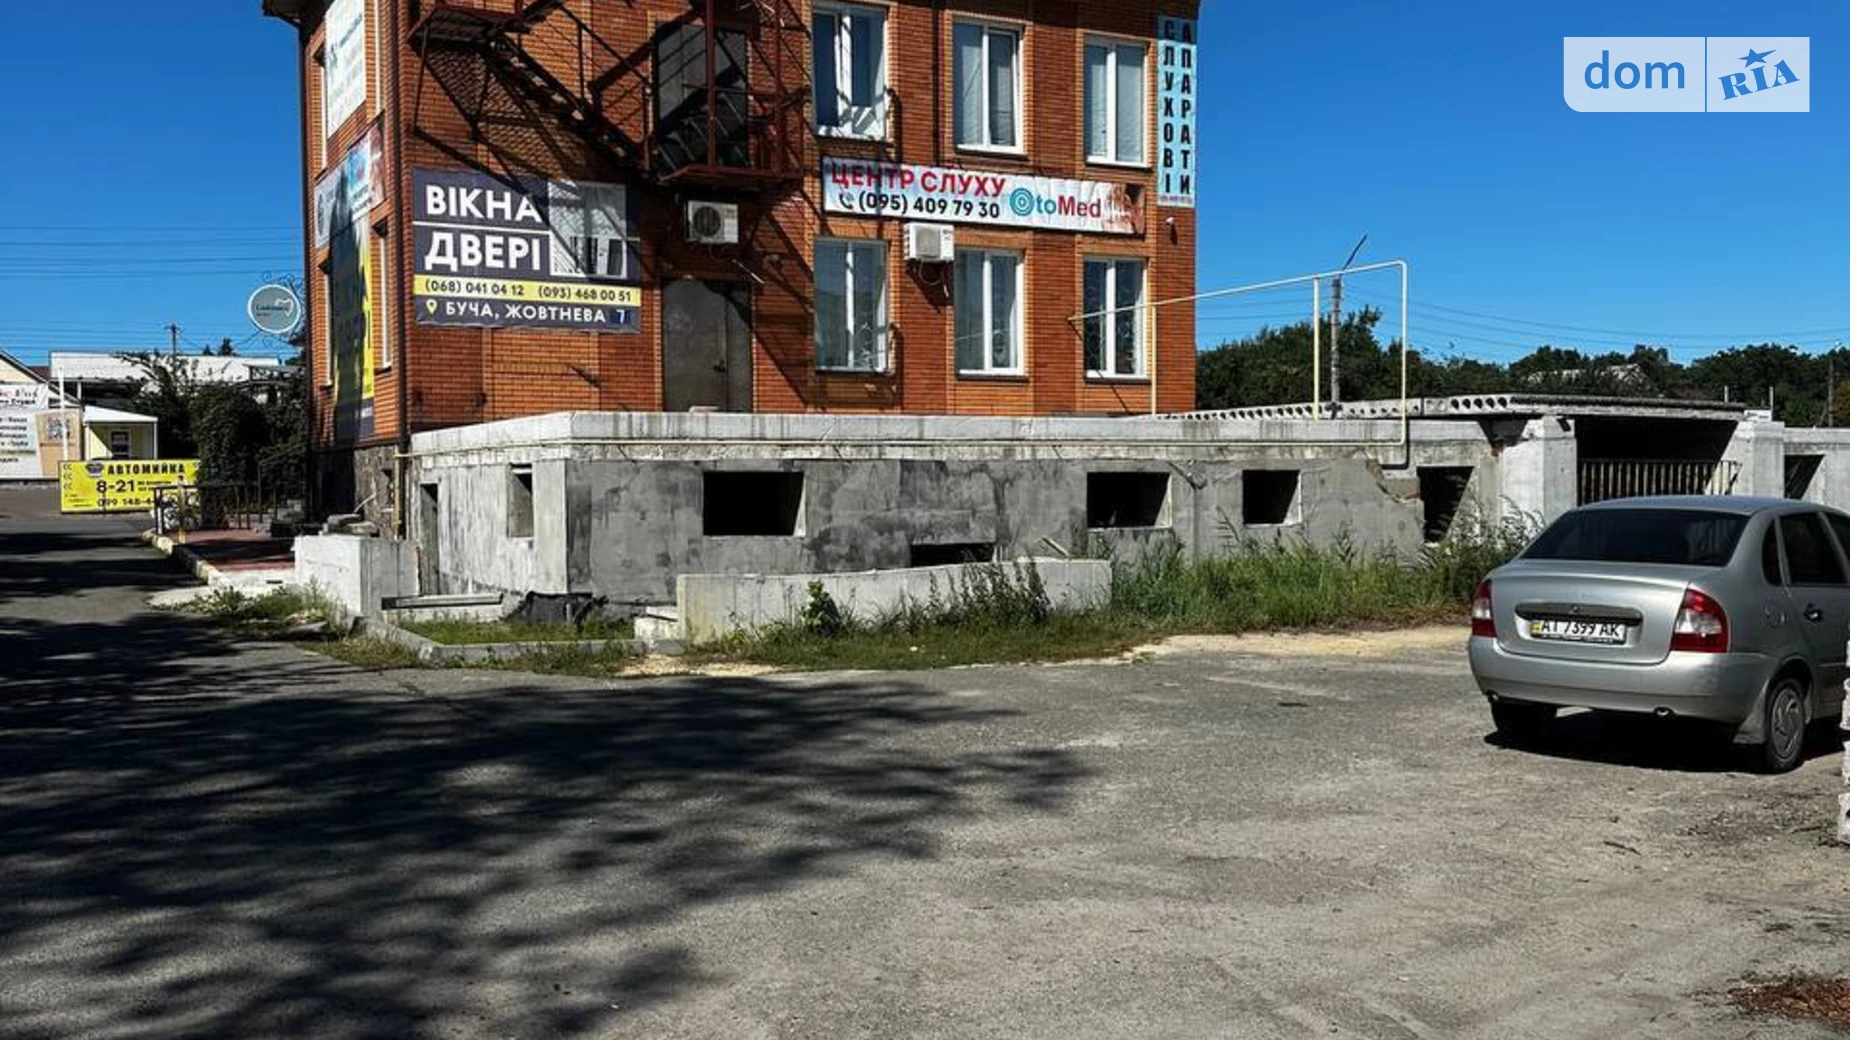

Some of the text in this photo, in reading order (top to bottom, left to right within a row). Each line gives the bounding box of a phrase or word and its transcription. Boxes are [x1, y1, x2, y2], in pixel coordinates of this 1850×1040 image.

[1163, 20, 1174, 193] СЛУХОВІ
[1180, 22, 1192, 195] АПАРАТИ
[832, 163, 1006, 198] ЦЕНТР СЛУХУ
[425, 184, 542, 223] ВІКНА
[859, 191, 1000, 218] (095) 409 79 30
[424, 231, 541, 272] ДВЕРІ
[425, 280, 632, 301] (068) 041 04 12 (093) 468 00 51
[445, 302, 626, 323] БУЧА, ЖОВТНЕВА 7
[107, 462, 185, 475] АВТОМИЙКА
[96, 480, 135, 493] 8-21
[1599, 624, 1619, 637] AK
